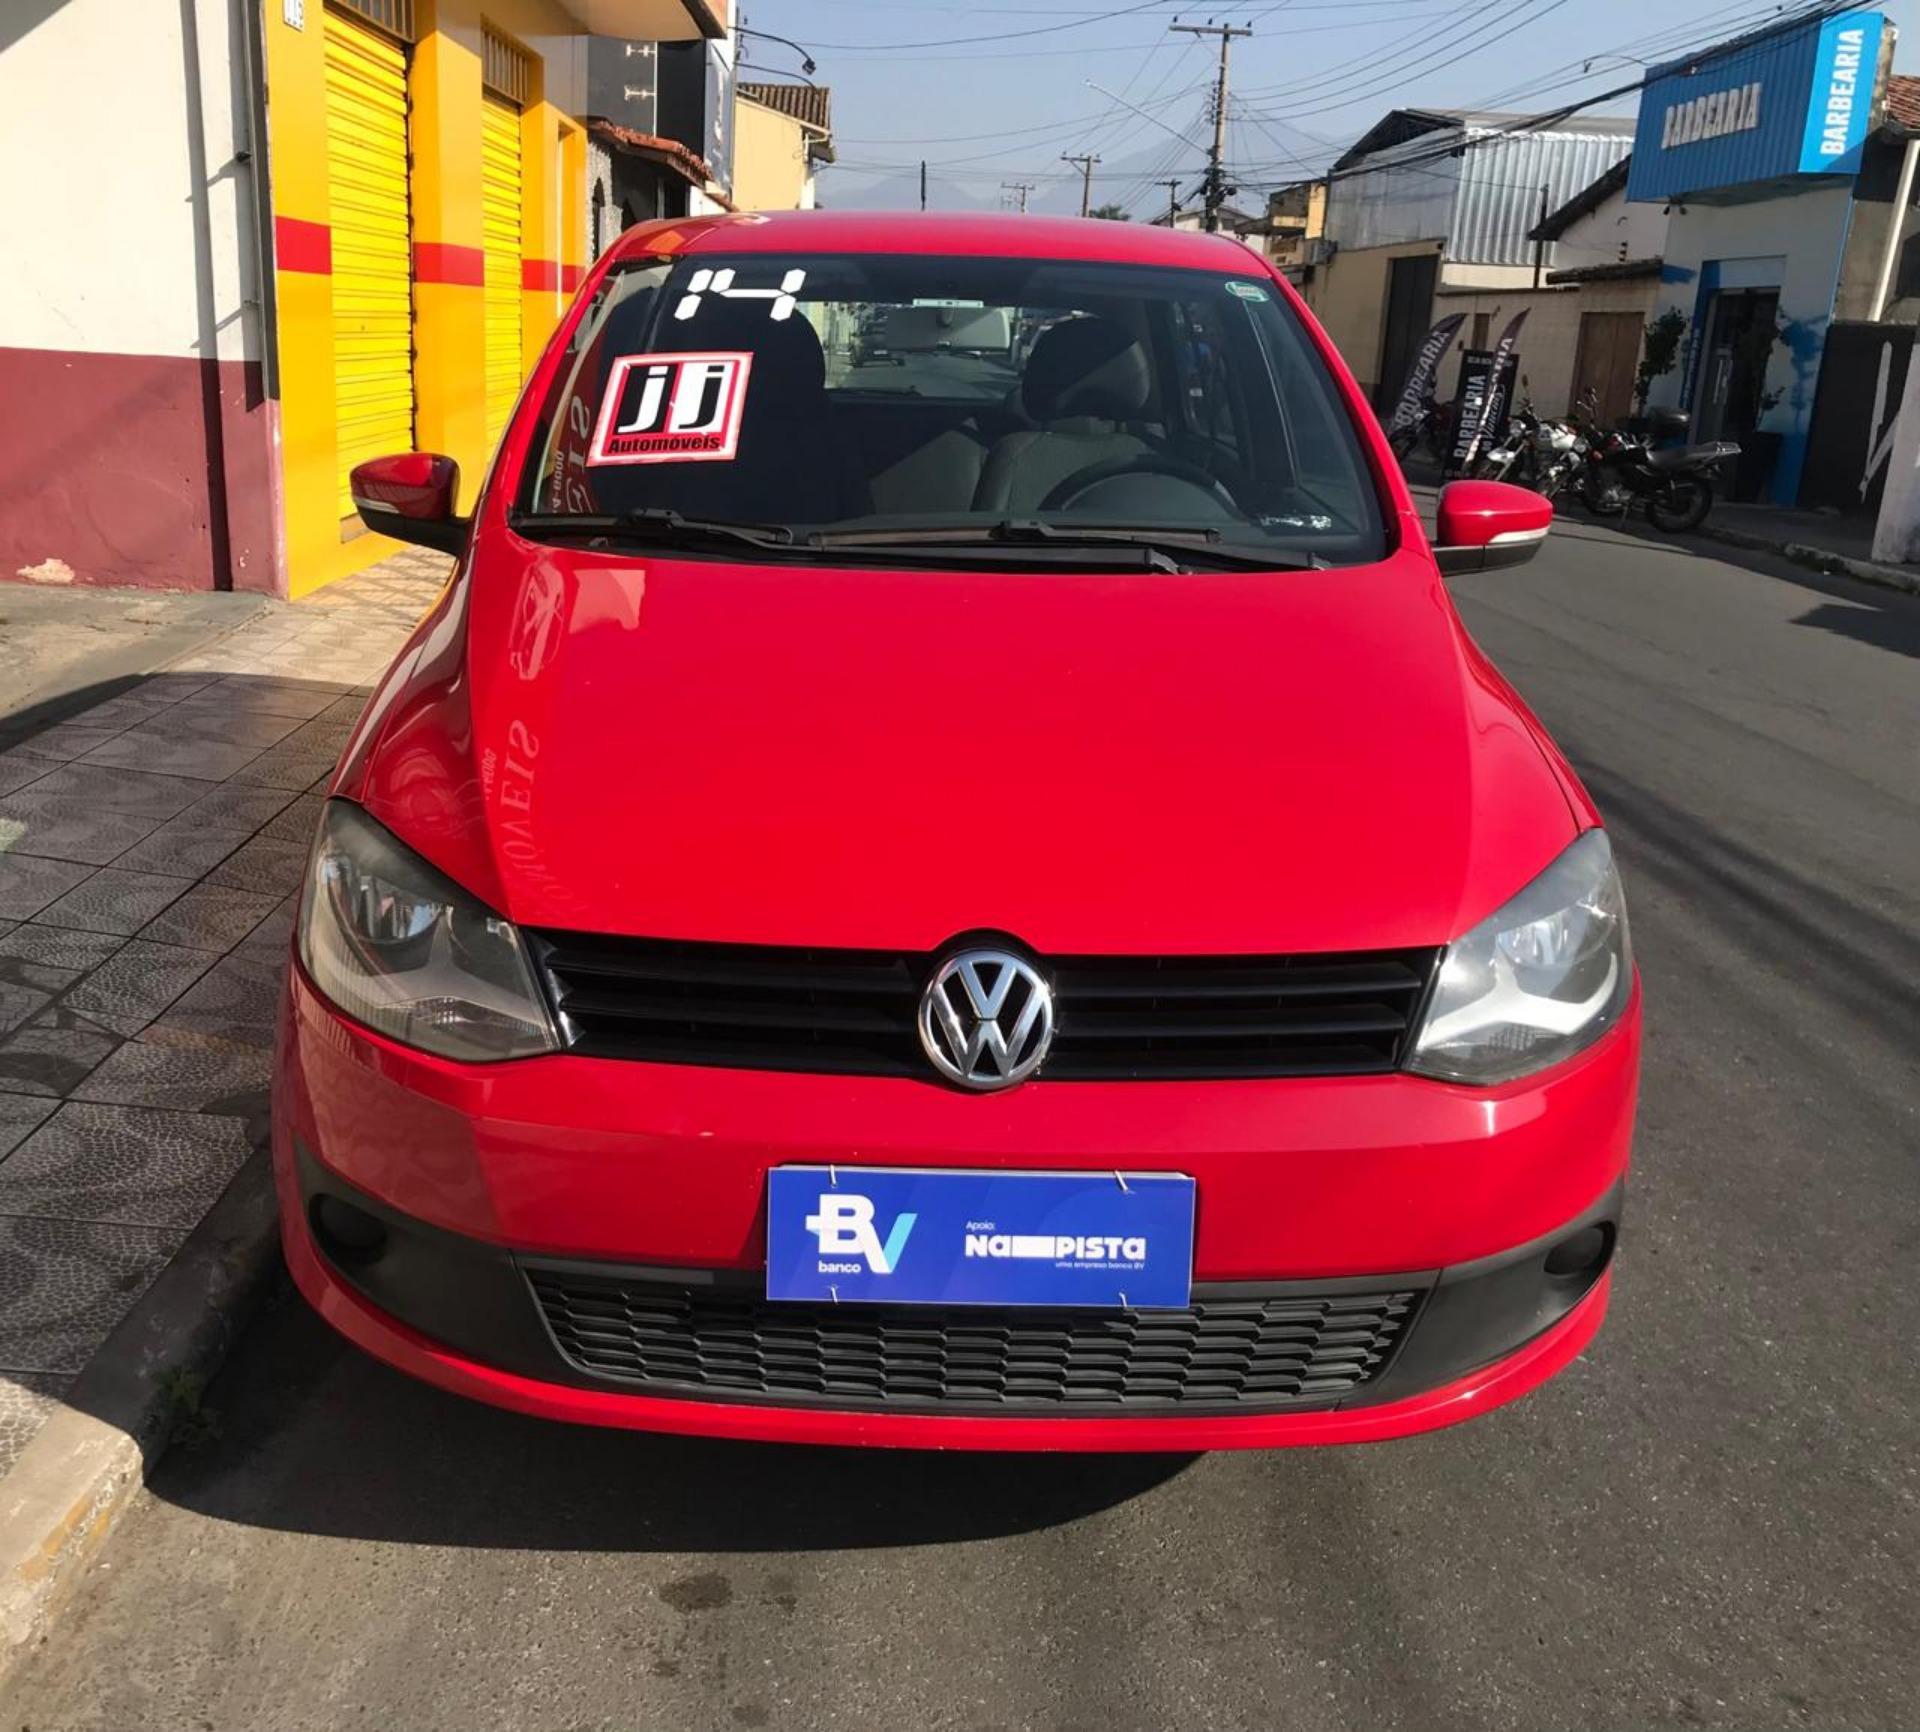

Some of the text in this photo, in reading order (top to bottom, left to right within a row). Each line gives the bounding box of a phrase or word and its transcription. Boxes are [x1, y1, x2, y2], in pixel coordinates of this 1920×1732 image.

[1661, 82, 1762, 149] BARBEARIA
[1818, 29, 1864, 155] BARBEARIA
[1453, 375, 1486, 458] BARBEARIA
[819, 1260, 862, 1273] banco
